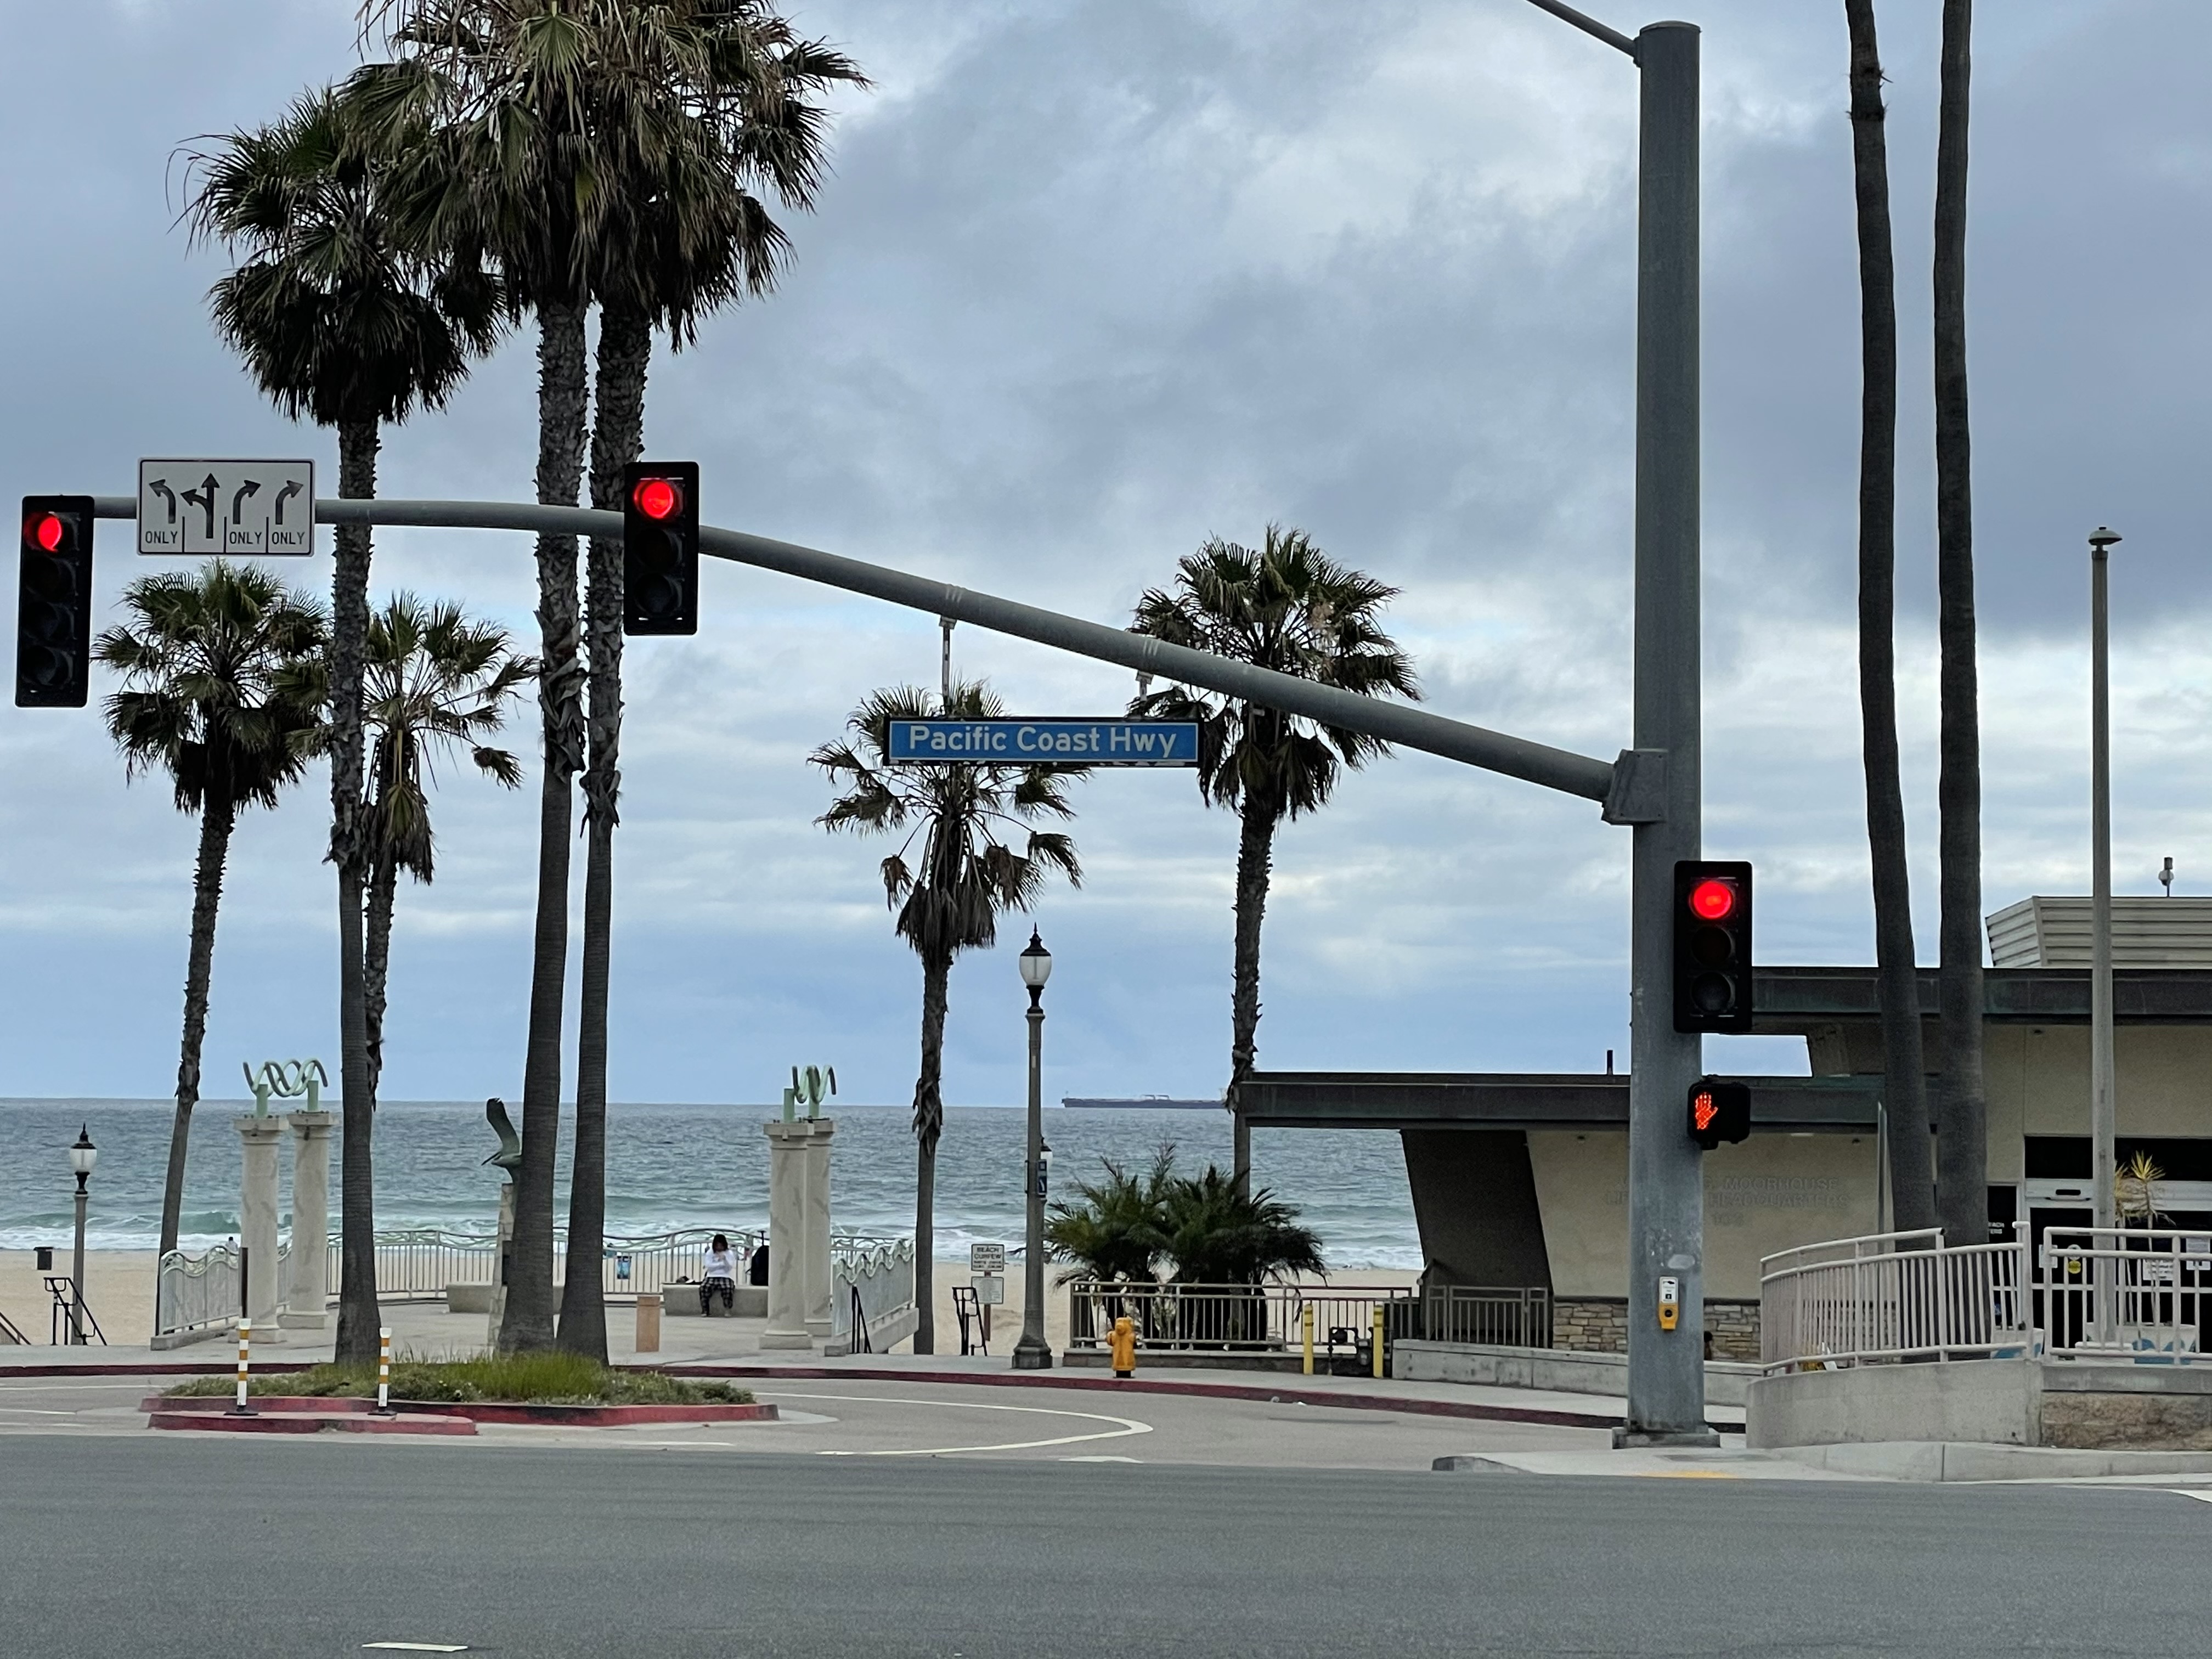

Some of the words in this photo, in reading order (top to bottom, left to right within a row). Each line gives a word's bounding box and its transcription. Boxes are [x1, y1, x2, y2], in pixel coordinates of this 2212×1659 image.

[145, 531, 178, 544] ONLY
[229, 531, 262, 545] ONLY
[271, 532, 305, 545] ONLY
[909, 725, 1007, 751] Pacific
[1017, 726, 1100, 752] Coast
[1110, 726, 1177, 758] Hwy
[1724, 1176, 1839, 1191] MOORHOUSE
[1708, 1192, 1850, 1209] HEADQUARTERS
